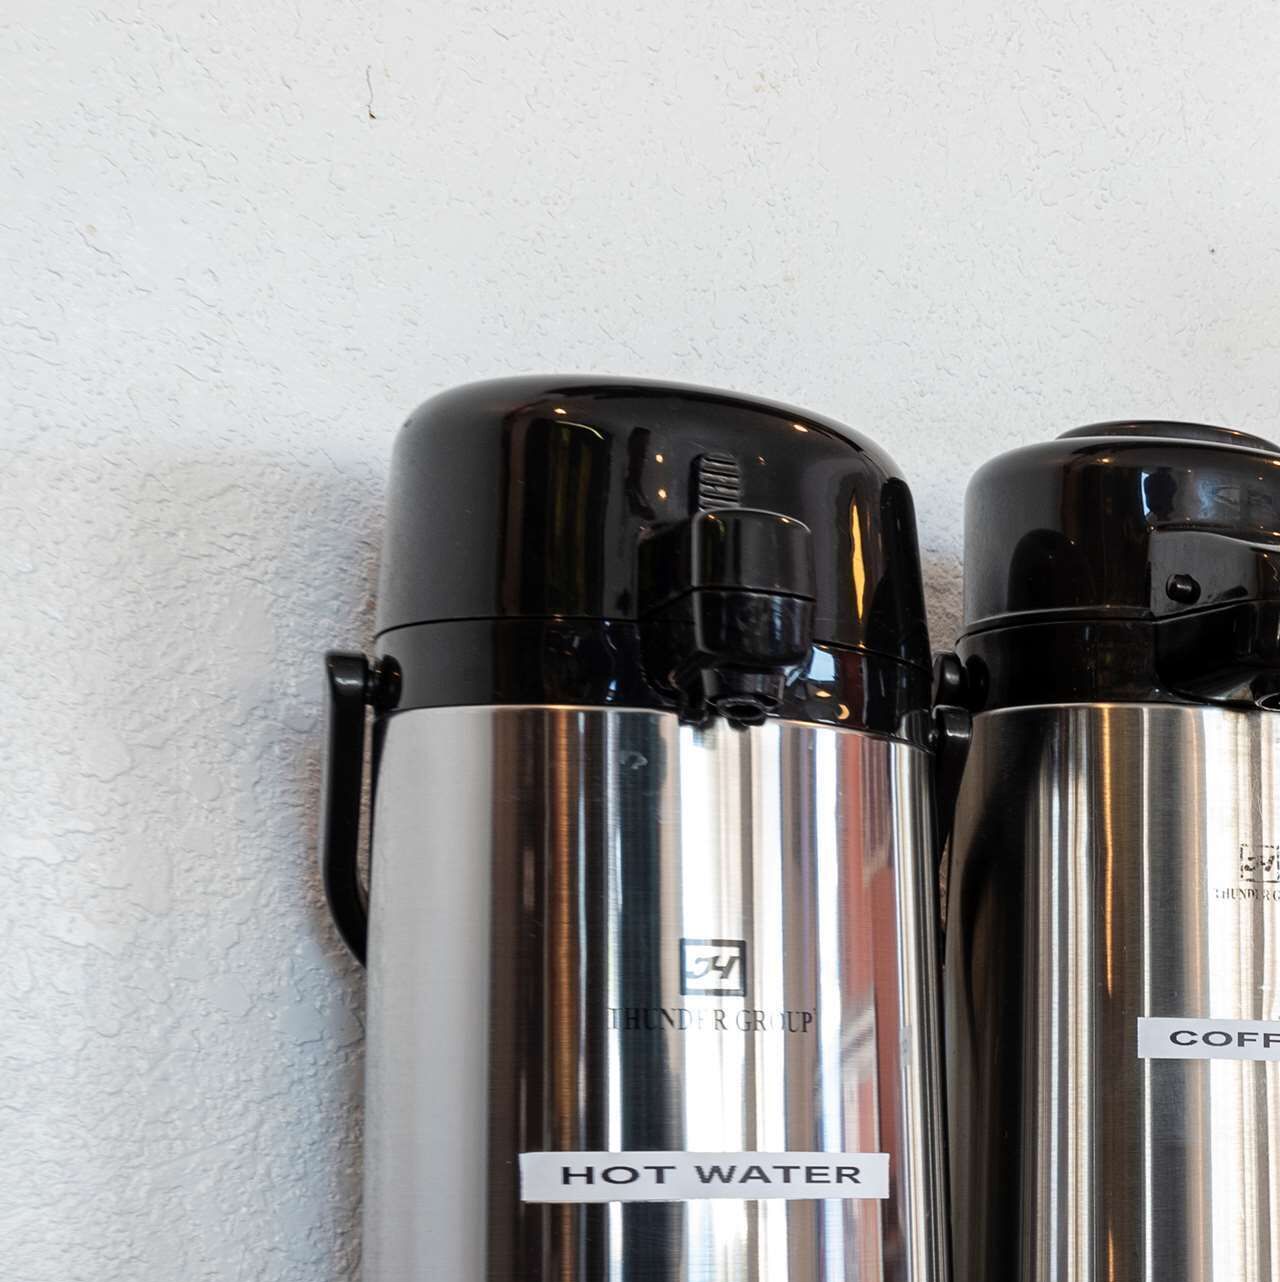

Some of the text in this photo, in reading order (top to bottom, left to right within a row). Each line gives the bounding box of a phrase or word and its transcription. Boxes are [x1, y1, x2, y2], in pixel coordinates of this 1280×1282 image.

[608, 1007, 728, 1032] THUNDR
[562, 1165, 862, 1185] HOT WATER
